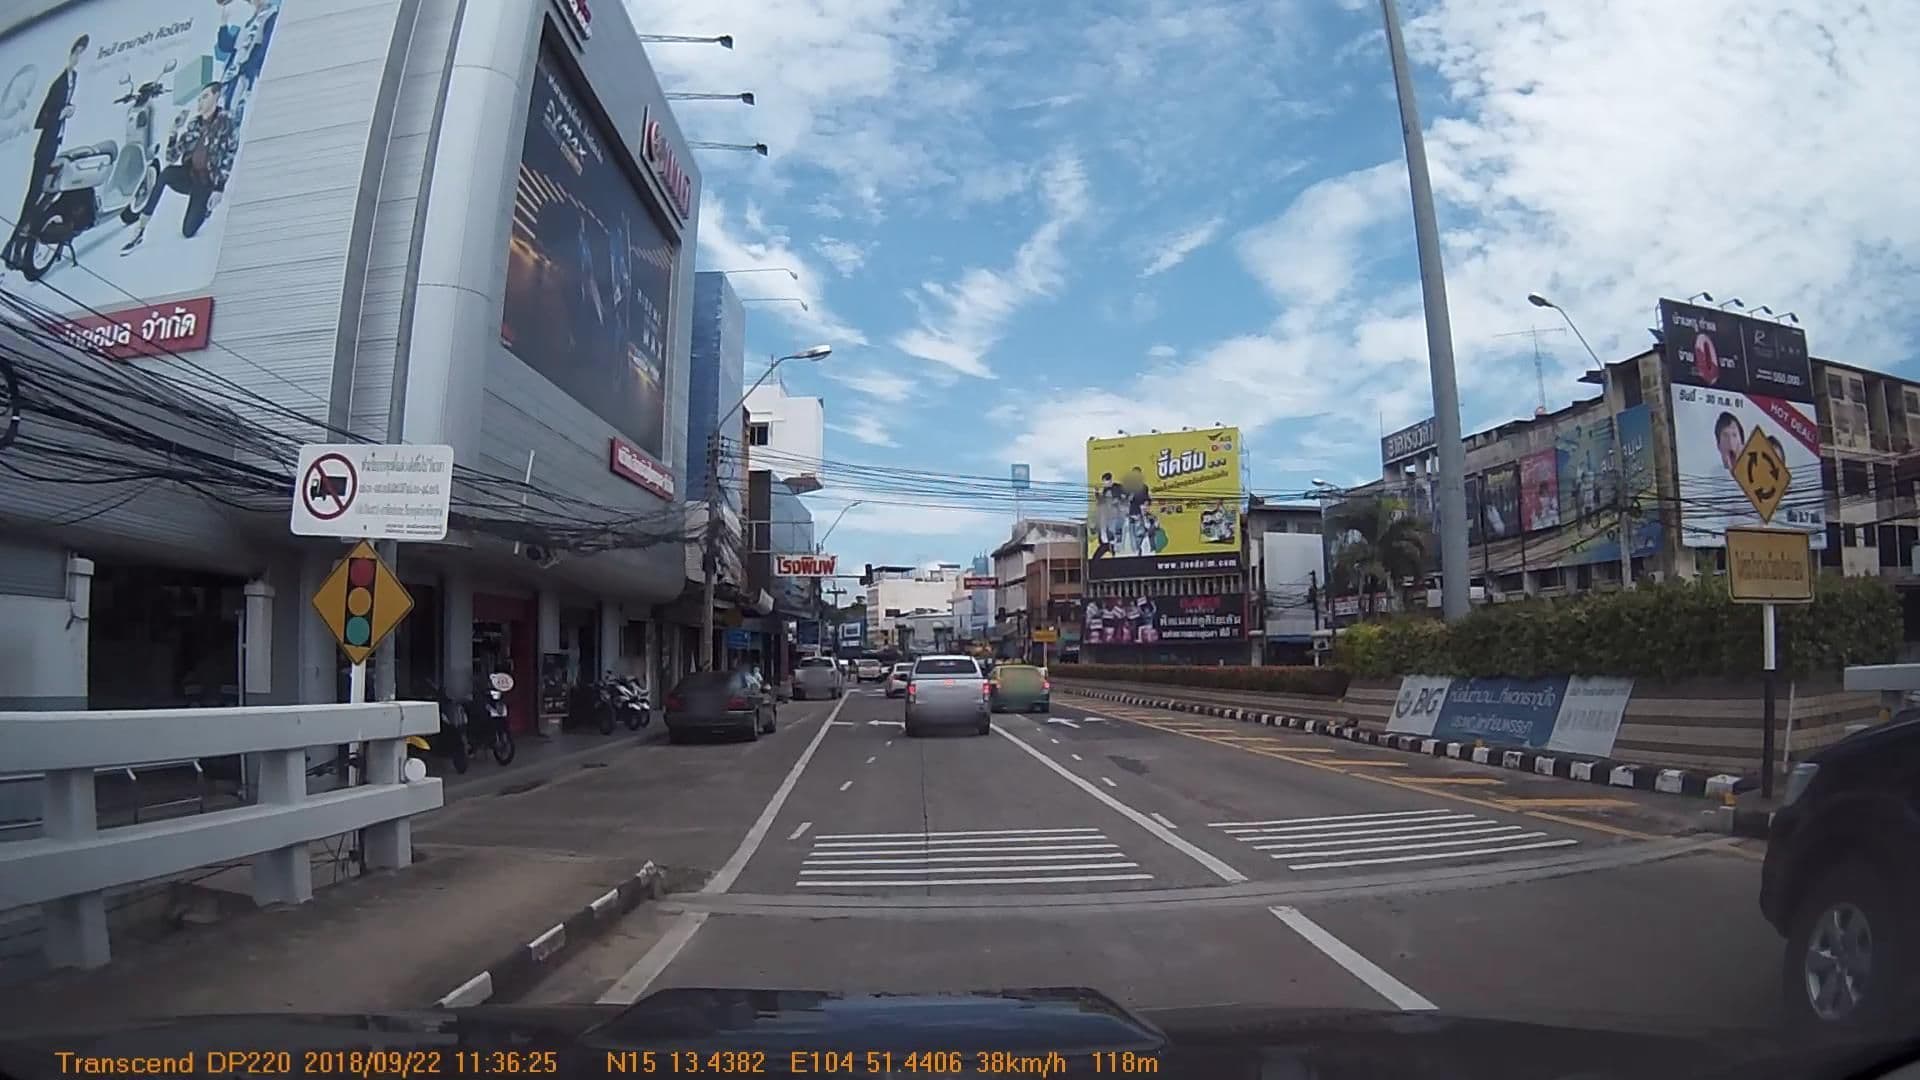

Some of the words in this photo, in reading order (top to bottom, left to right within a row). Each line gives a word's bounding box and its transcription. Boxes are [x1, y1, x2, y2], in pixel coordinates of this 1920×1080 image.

[142, 307, 197, 340] จำกัด
[1770, 403, 1790, 422] HOT
[776, 555, 837, 575] โรงพิมพ์
